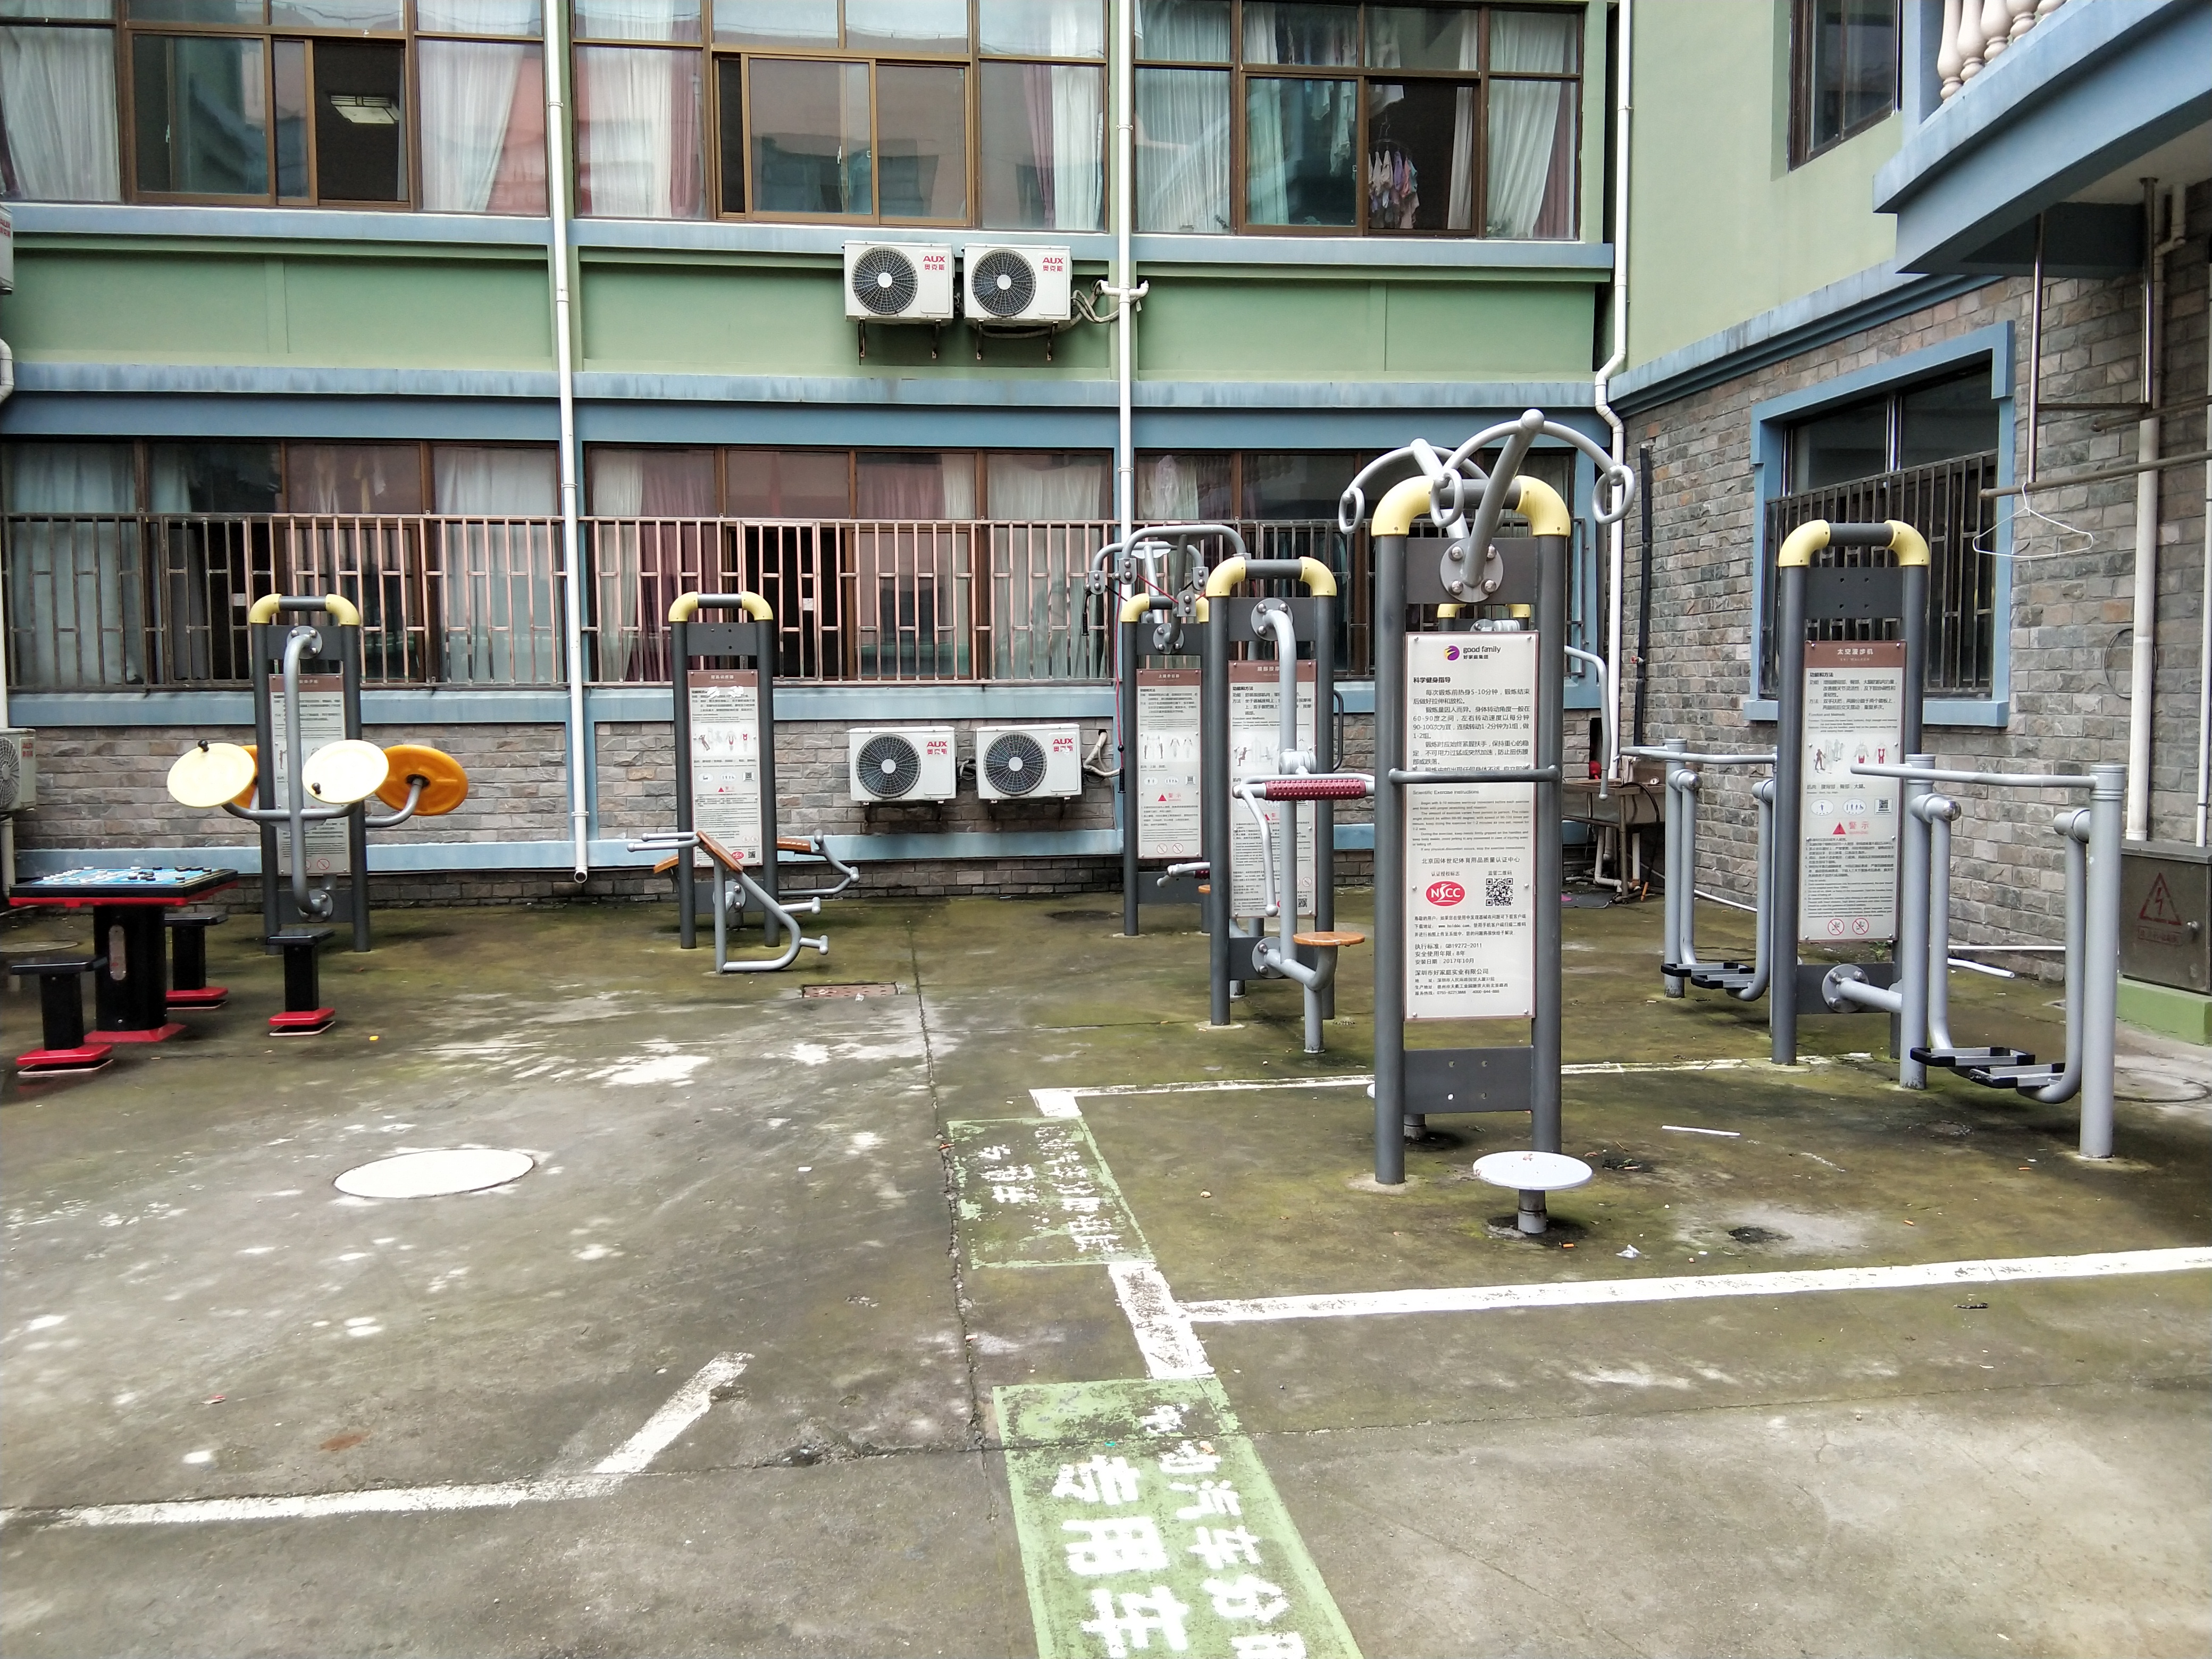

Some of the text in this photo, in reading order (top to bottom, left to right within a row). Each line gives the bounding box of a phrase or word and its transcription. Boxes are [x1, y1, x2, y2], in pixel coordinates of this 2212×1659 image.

[1431, 883, 1461, 901] NSCC
[1051, 1454, 1190, 1658] 专用车
